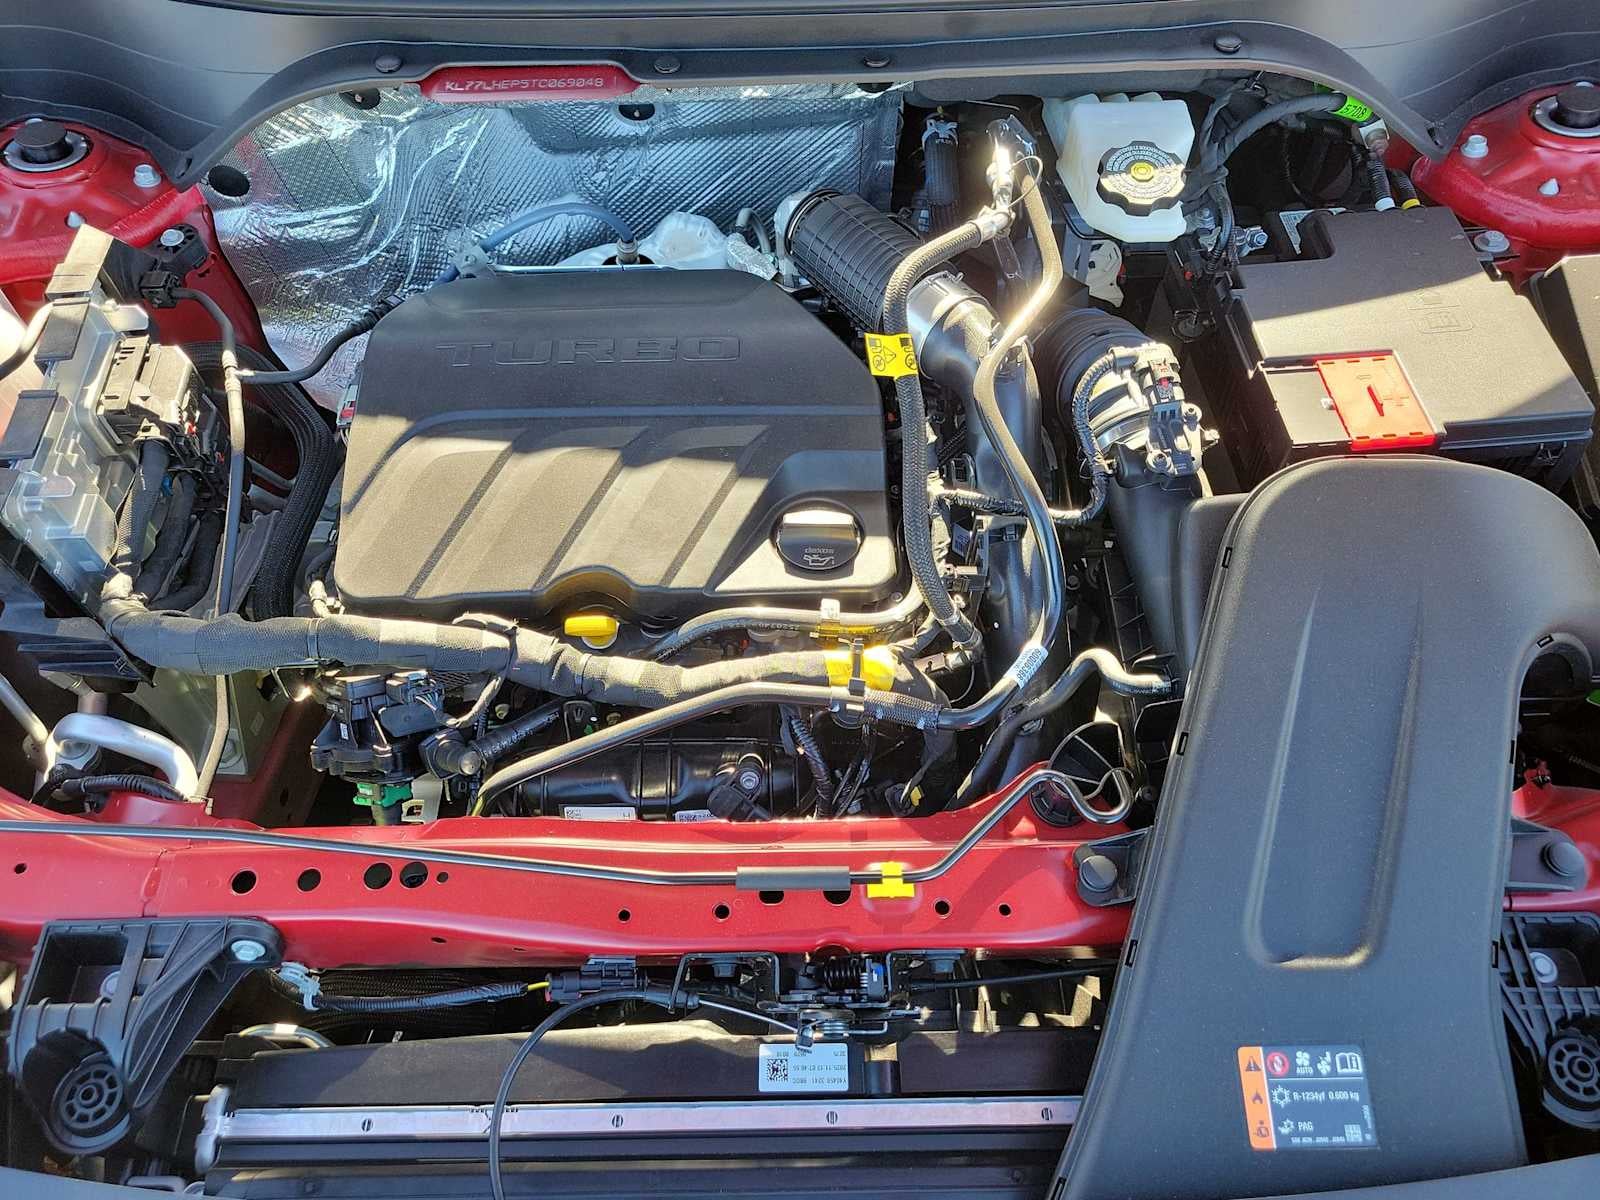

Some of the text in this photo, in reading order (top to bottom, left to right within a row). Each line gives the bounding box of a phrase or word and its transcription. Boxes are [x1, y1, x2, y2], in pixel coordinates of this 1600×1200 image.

[444, 77, 604, 91] KL77LHEP5TC069048
[435, 336, 742, 367] TURBO
[1296, 1066, 1314, 1074] AUTO
[1350, 1091, 1360, 1102] kg
[1298, 1121, 1313, 1131] PAG
